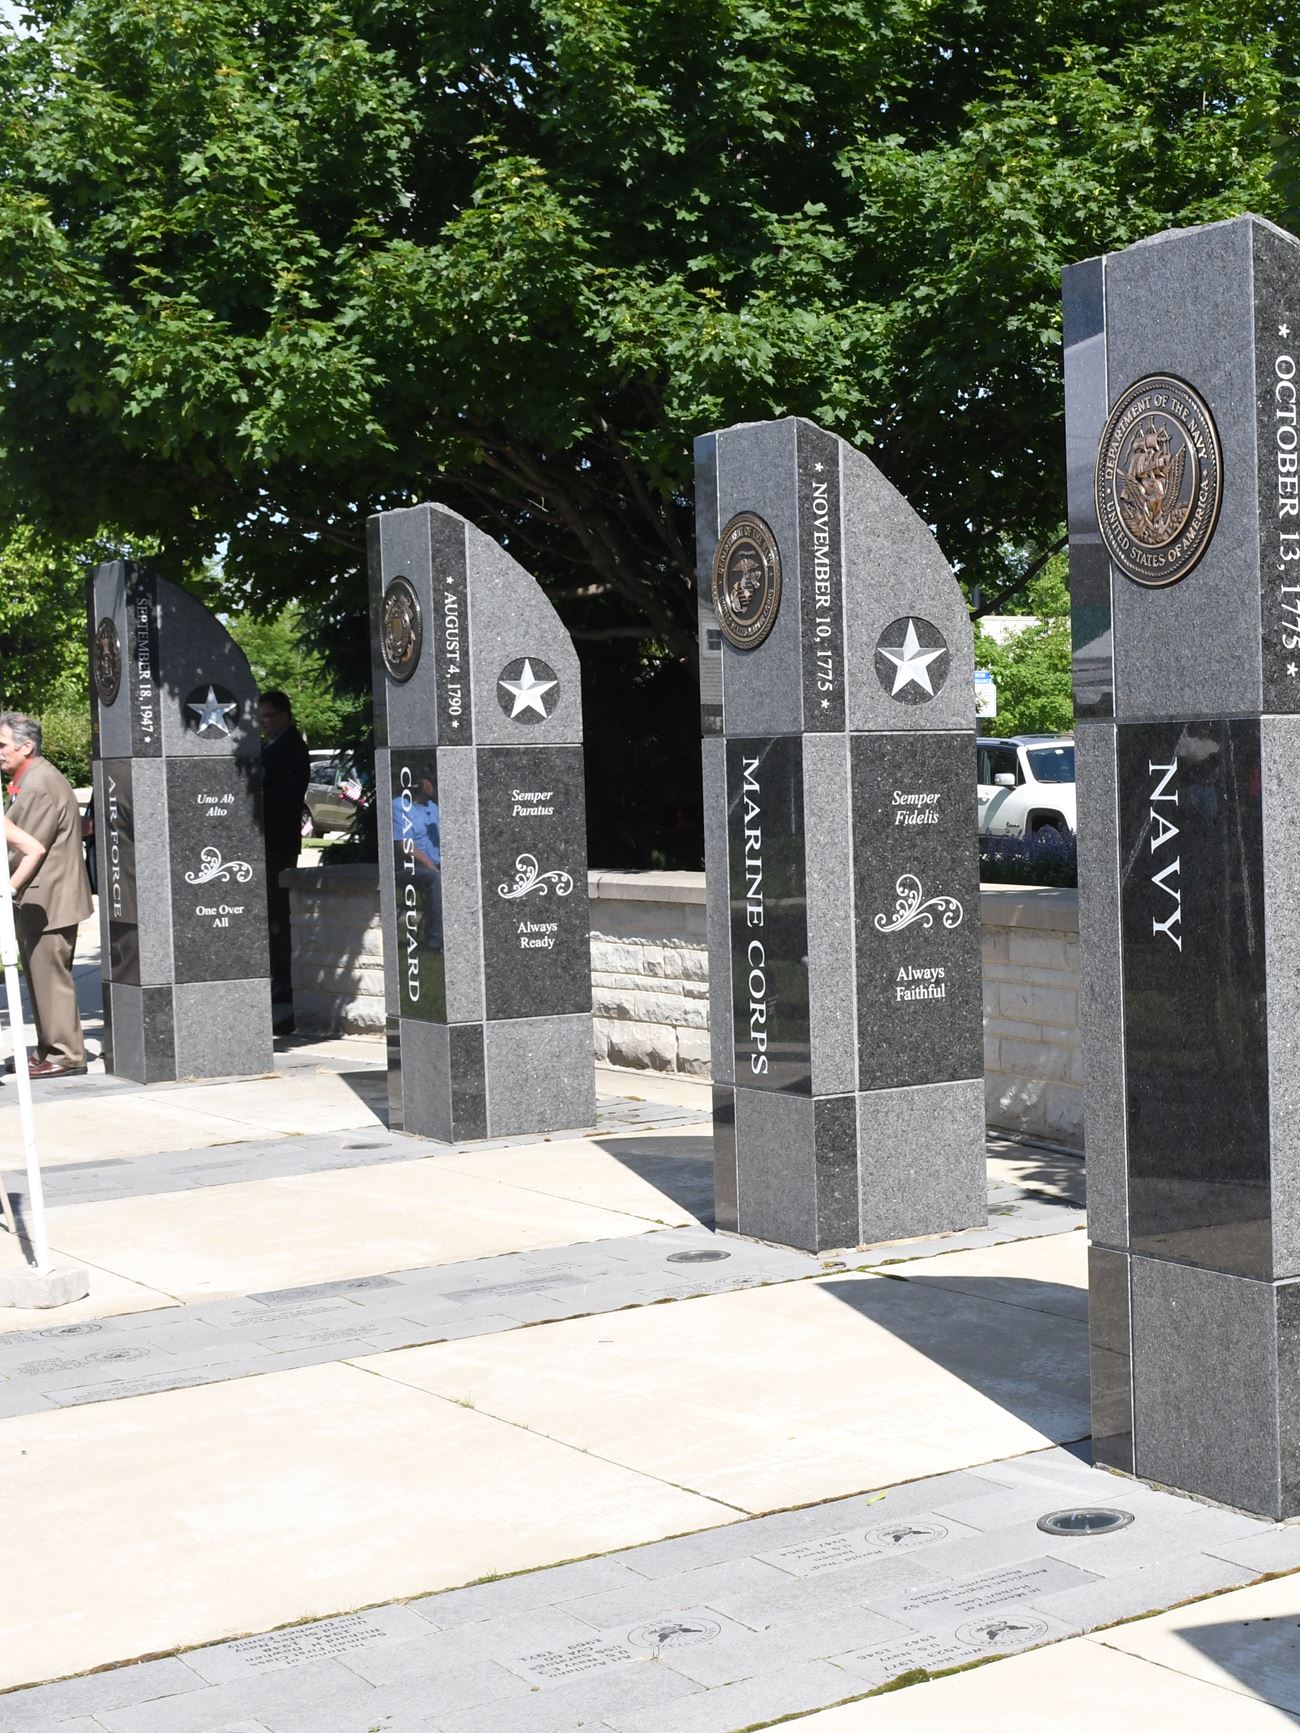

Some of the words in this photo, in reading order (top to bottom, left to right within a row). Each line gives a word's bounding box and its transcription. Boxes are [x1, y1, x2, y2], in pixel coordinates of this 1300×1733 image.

[1105, 395, 1152, 480] DEPARTMENT
[1154, 394, 1169, 408] OF
[1171, 398, 1190, 419] THE
[1188, 418, 1209, 460] NAVY
[1275, 355, 1299, 519] OCTOBER
[1107, 501, 1130, 550] UNITED
[1130, 548, 1166, 567] STATES
[1168, 543, 1182, 562] OF
[1183, 479, 1209, 551] AMERICA
[812, 482, 830, 608] NOVEMBER
[1278, 532, 1300, 571] 13,
[136, 597, 151, 679] SEPTEMBER
[445, 592, 459, 660] AUGUST
[814, 617, 831, 643] 10,
[447, 665, 460, 679] 4,
[817, 650, 833, 691] 1775
[137, 683, 150, 702] 18,
[448, 683, 461, 716] 1790
[140, 704, 154, 733] 1947
[108, 776, 117, 819] AIR
[197, 794, 217, 805] Uno
[219, 793, 234, 804] Ab
[206, 807, 227, 816] Alto
[511, 789, 553, 804] Semper
[512, 804, 554, 817] Paratus
[892, 790, 940, 807] Semper
[400, 766, 415, 876] COAST
[895, 811, 939, 825] Fidelis
[743, 756, 764, 928] MARINE
[1148, 759, 1181, 952] NAVY
[110, 832, 122, 918] FORCE
[196, 906, 216, 916] One
[219, 905, 244, 915] Over
[213, 917, 229, 928] All
[404, 884, 420, 1002] GUARD
[517, 921, 558, 935] Always
[520, 935, 555, 950] Ready
[896, 966, 945, 984] Always
[748, 940, 768, 1075] CORPS
[896, 984, 946, 1001] Faithful
